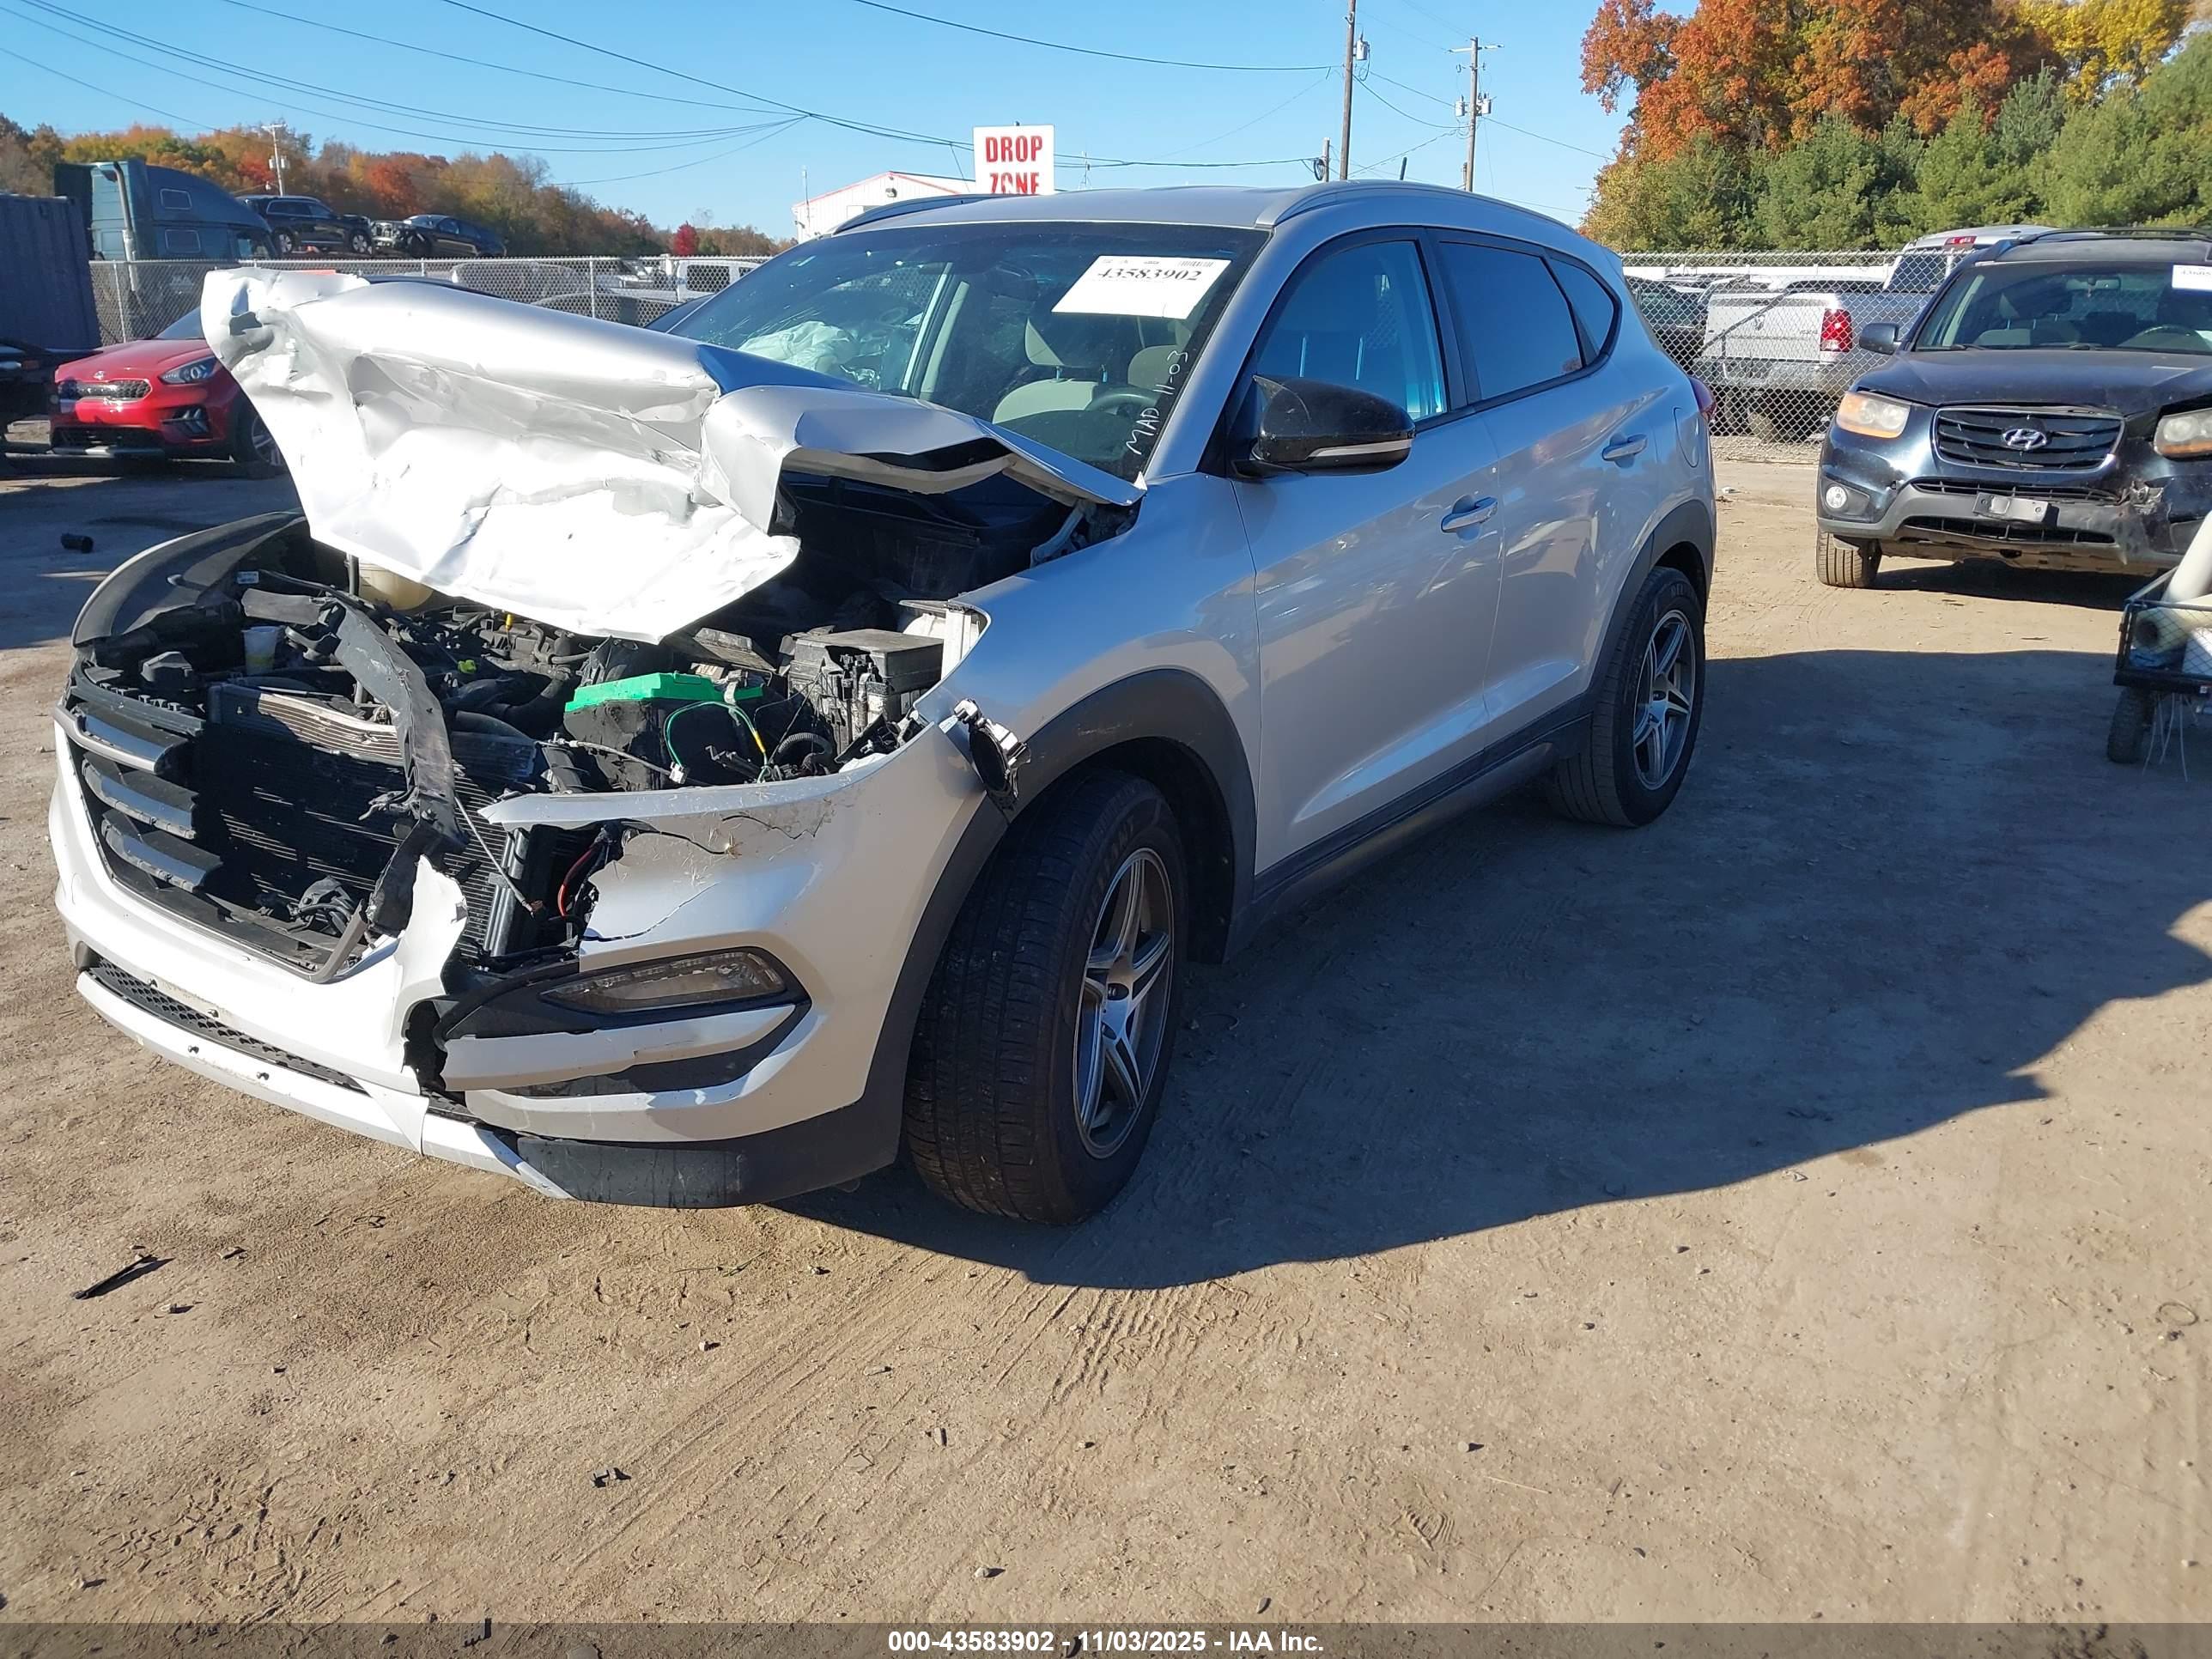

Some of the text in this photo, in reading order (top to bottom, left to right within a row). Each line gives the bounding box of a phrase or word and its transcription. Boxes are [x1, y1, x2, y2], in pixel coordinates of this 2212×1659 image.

[985, 135, 1042, 162] DROP
[989, 172, 1039, 194] ZONE
[1097, 267, 1202, 281] 43583902
[1126, 407, 1160, 455] MAD
